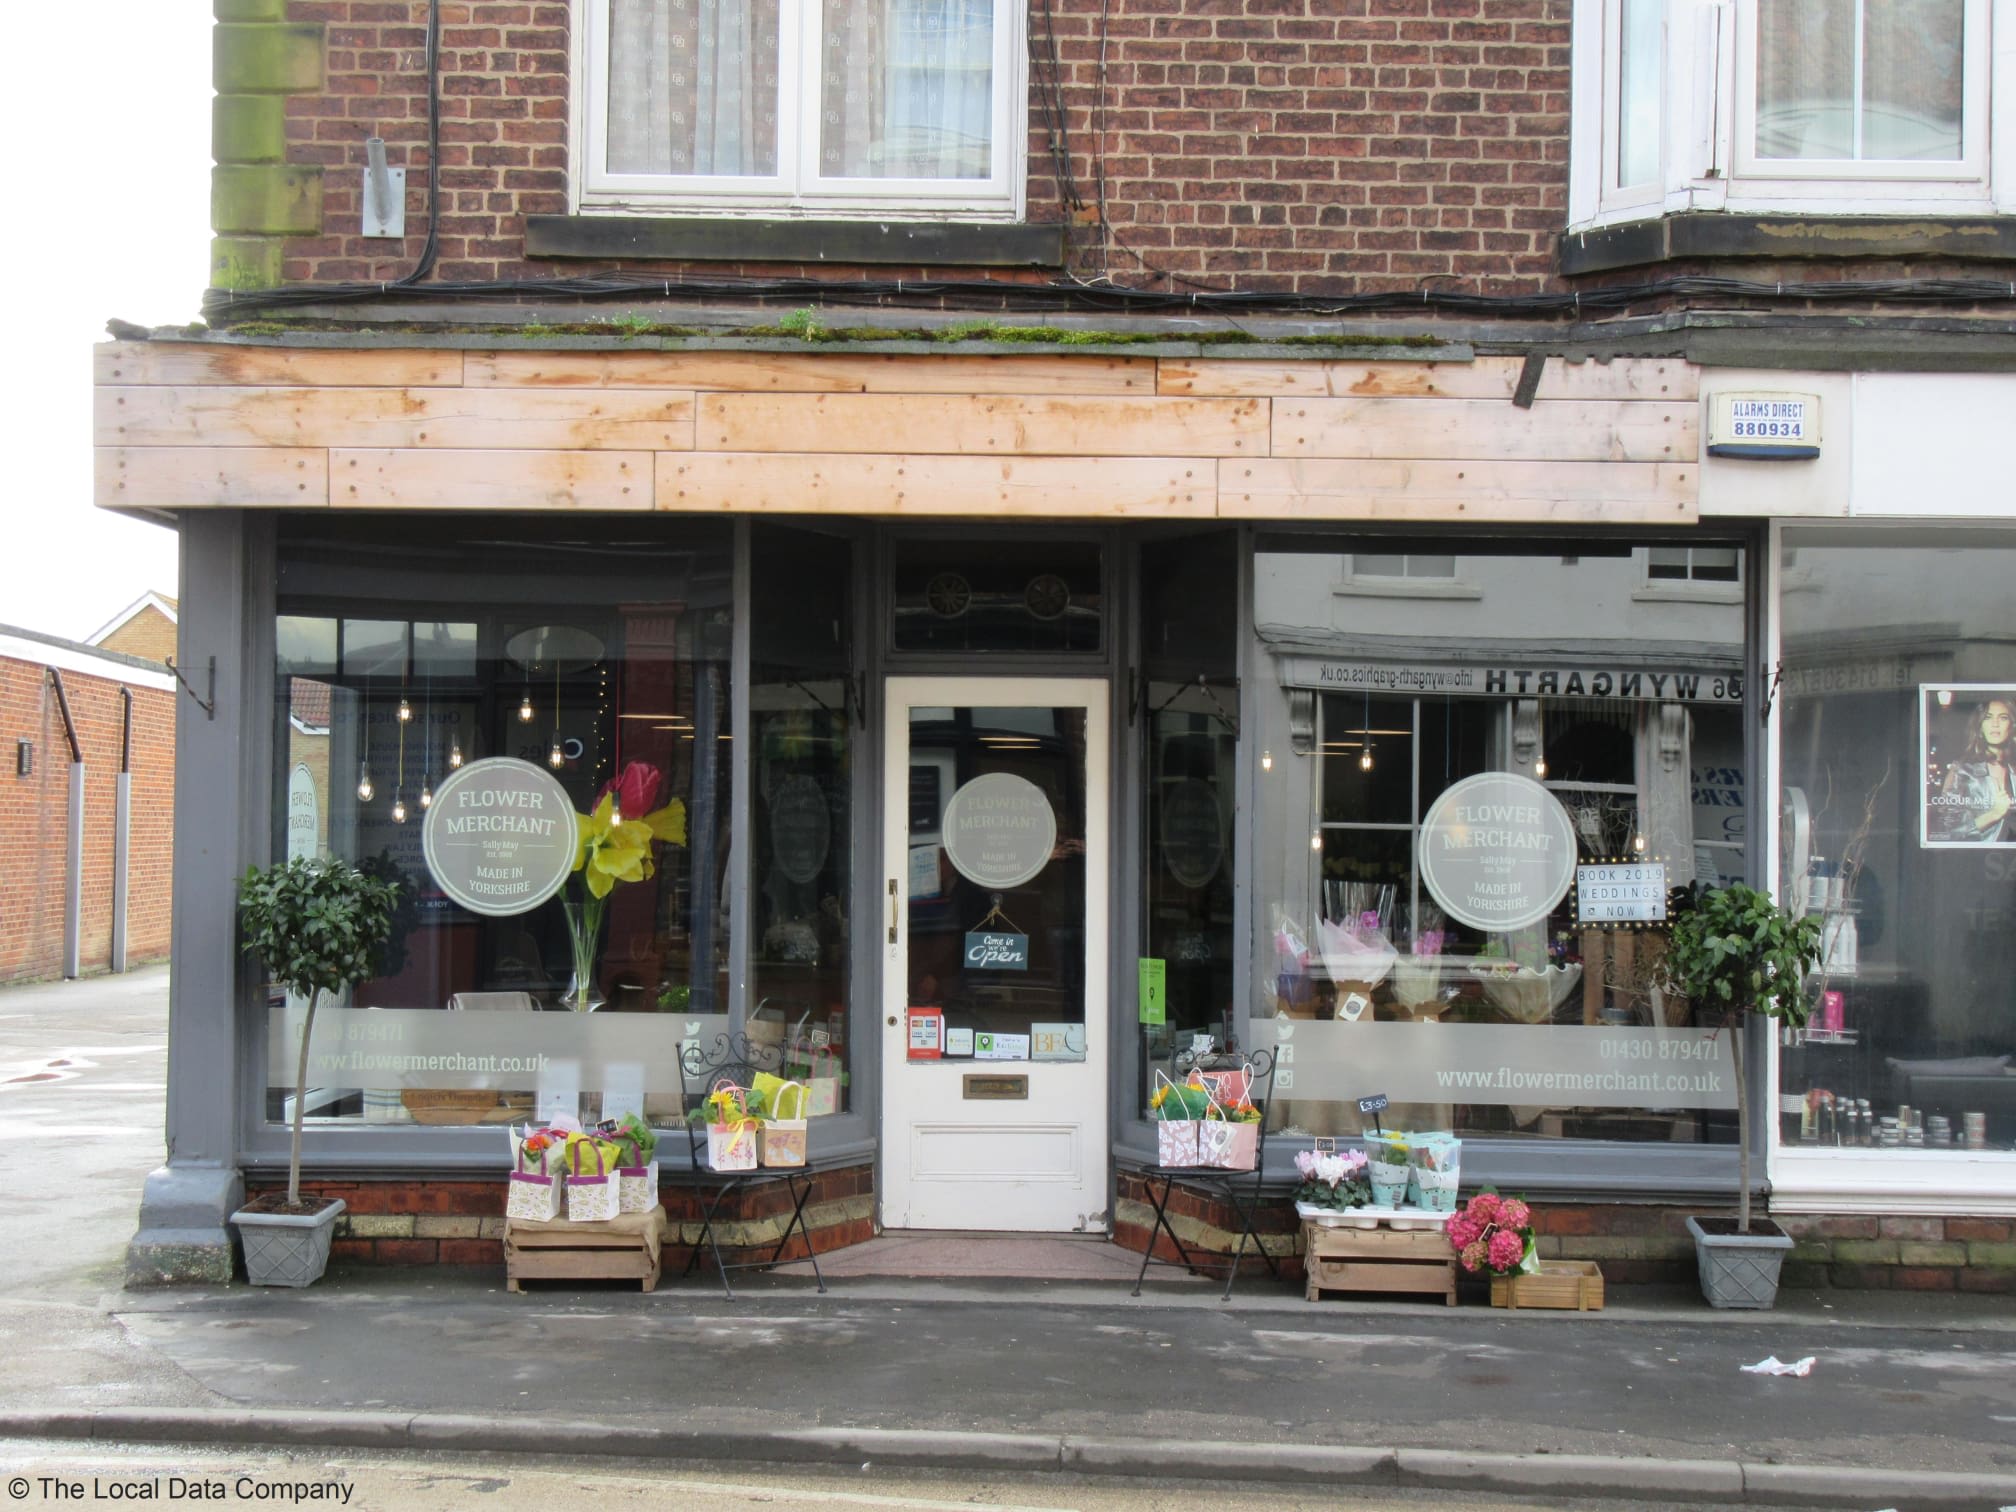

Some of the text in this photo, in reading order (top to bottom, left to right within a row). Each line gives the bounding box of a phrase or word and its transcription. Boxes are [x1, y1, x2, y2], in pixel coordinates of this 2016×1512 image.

[1733, 402, 1803, 418] ALARMS DIRECT
[1734, 422, 1801, 437] 880934
[457, 789, 544, 810] FLOWER
[967, 797, 1030, 811] FLOWER
[1931, 795, 1971, 806] COLOUR
[1455, 804, 1543, 825] FLOWER
[445, 815, 557, 837] MERCHANT
[960, 815, 1039, 830] MERCHANT
[1442, 829, 1554, 851] MERCHANT
[476, 865, 523, 880] MADE IN
[1578, 868, 1663, 881] BOOK 2019
[469, 880, 531, 895] YORKSHIRE
[1474, 881, 1521, 895] MADE IN
[1579, 887, 1660, 899] WEDDINGS
[1467, 895, 1530, 911] YORKSHIRE
[1606, 905, 1636, 917] NOW
[983, 935, 1014, 946] Come in
[967, 945, 1024, 967] Open
[1600, 1039, 1720, 1061] 01430 879471
[1436, 1067, 1721, 1093] www.flowermerchant.co.uk
